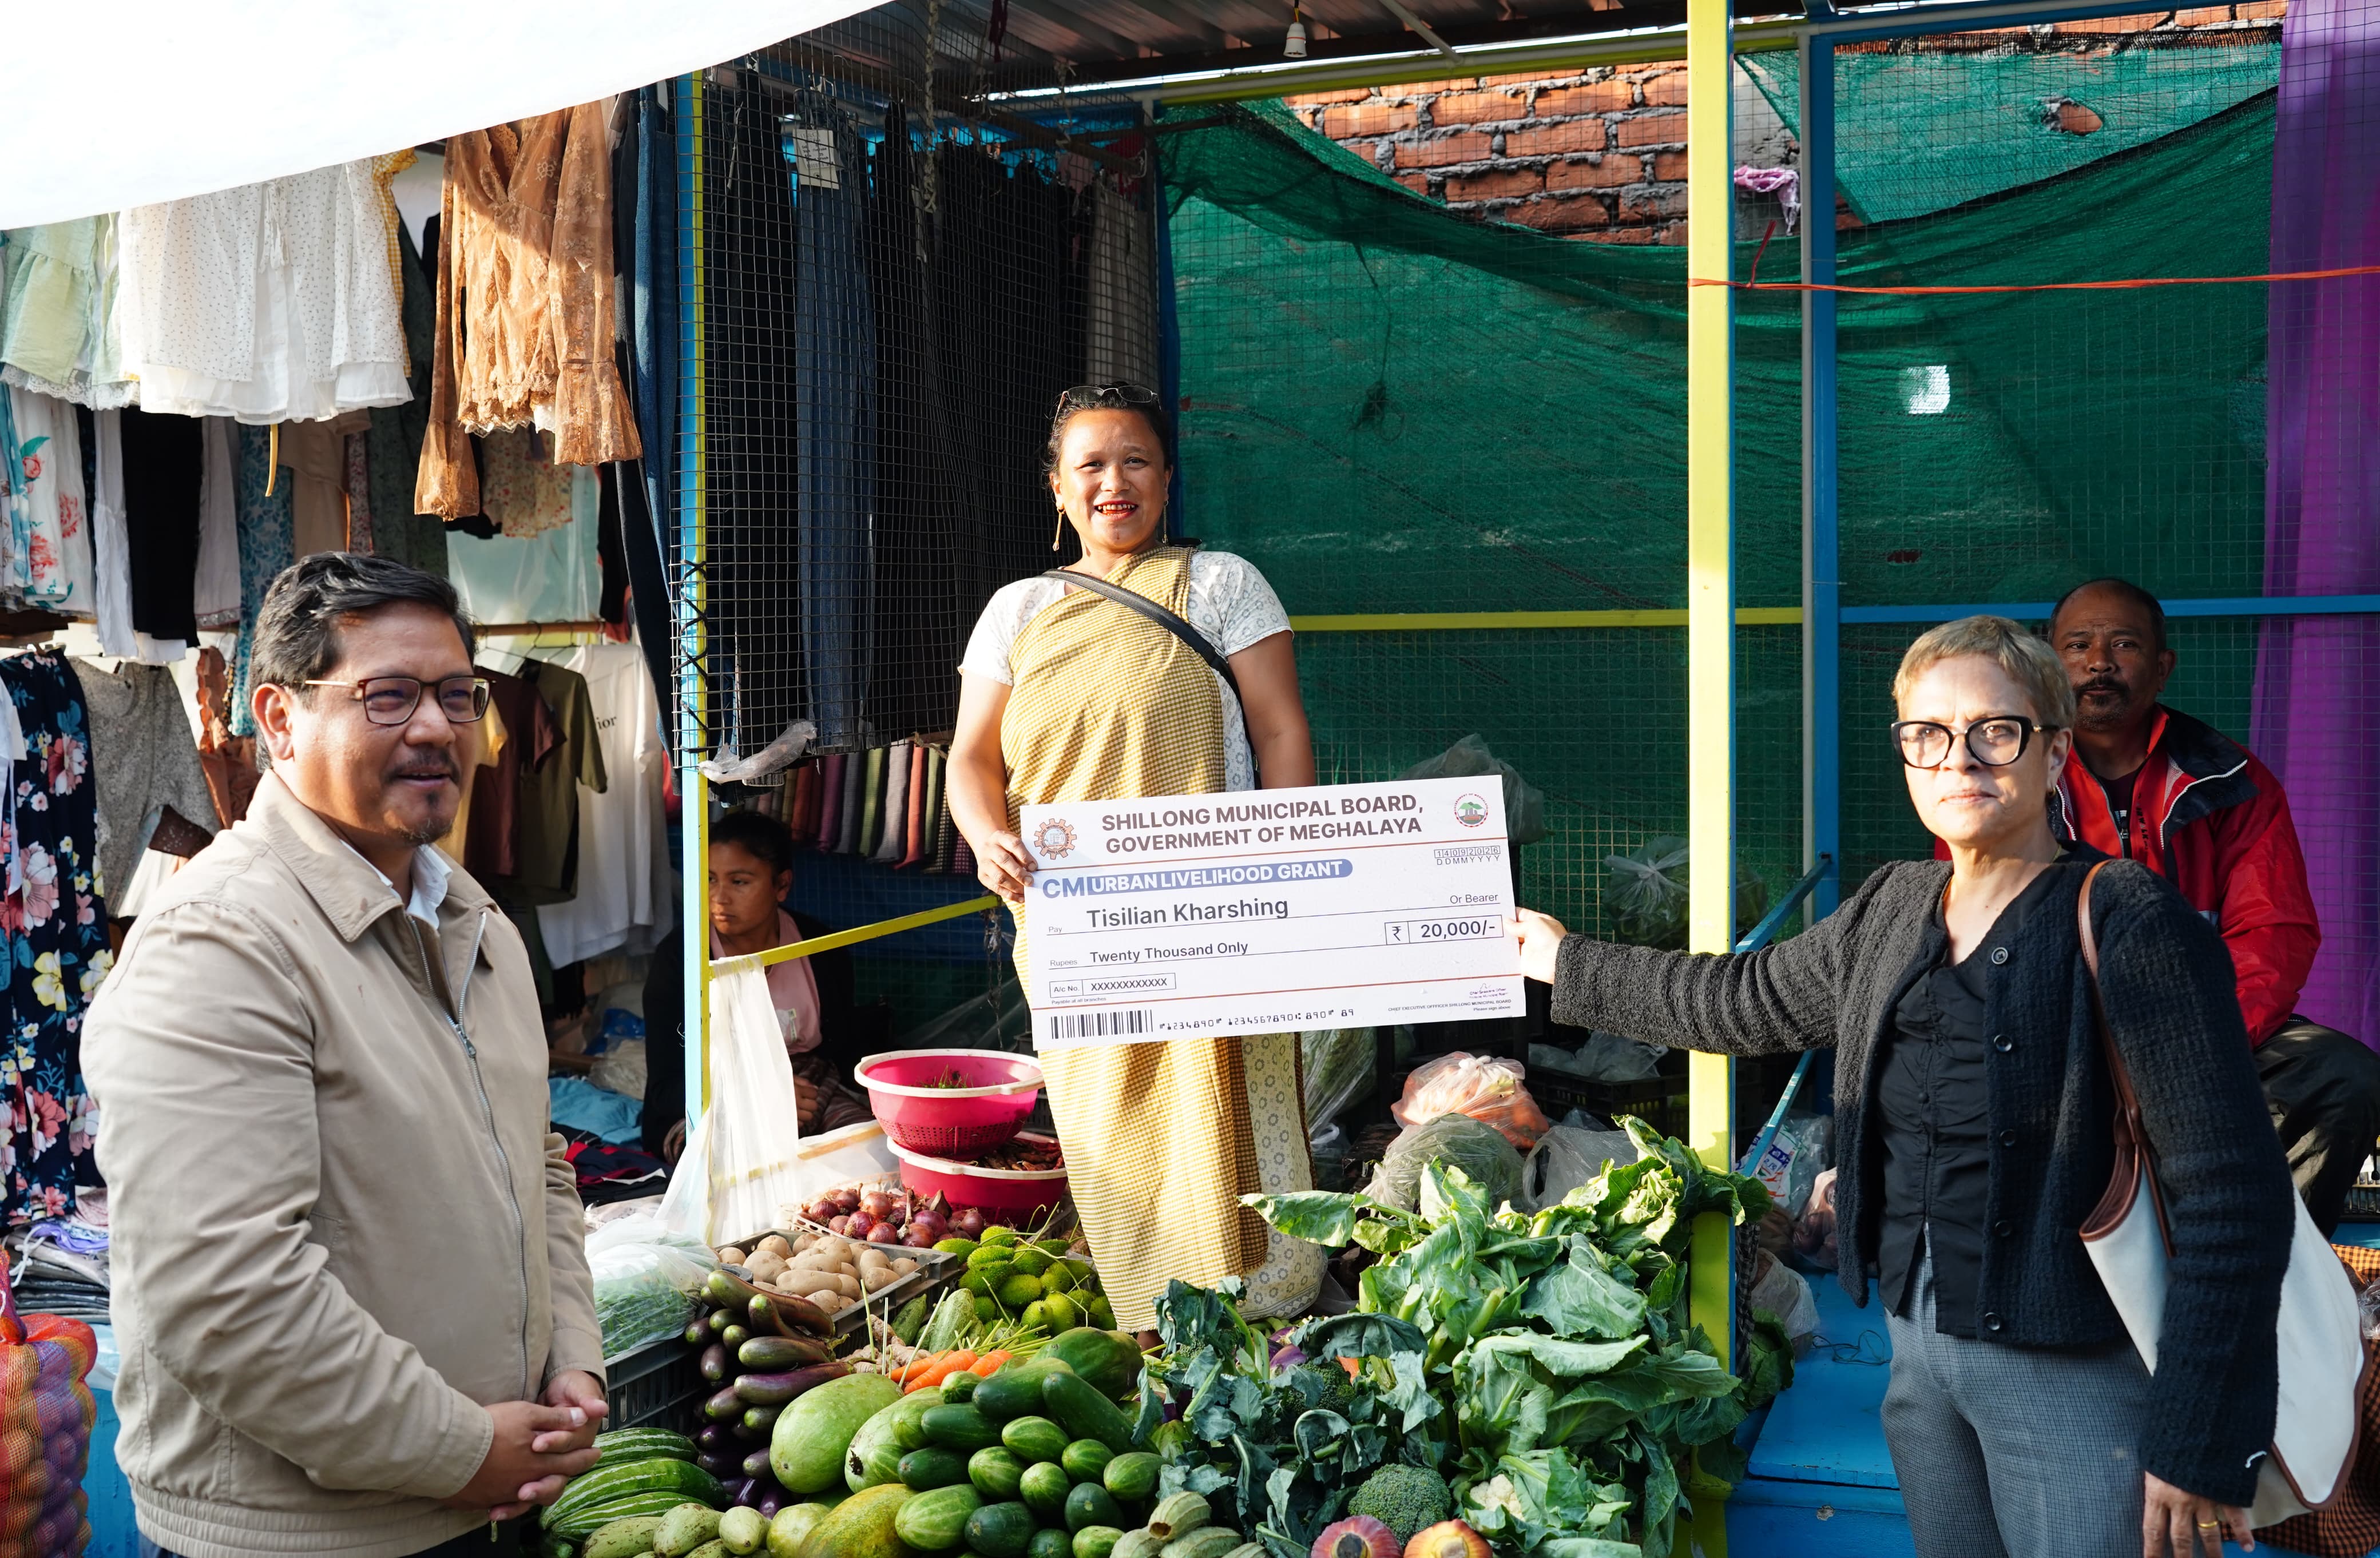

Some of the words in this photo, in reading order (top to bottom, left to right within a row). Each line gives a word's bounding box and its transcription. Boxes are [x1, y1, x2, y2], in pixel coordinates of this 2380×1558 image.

[597, 716, 617, 730] ior
[1102, 809, 1210, 830] SHILLONG
[1216, 800, 1336, 823] MUNICIPAL
[1341, 794, 1423, 814] BOARD,
[1106, 829, 1252, 853] GOVERNMENT
[1258, 826, 1284, 842] OF
[1290, 817, 1422, 841] MEGHALAYA
[1042, 878, 1084, 899] CM
[1091, 873, 1157, 892] URBAN
[1161, 867, 1272, 887] LIVELIHOOD
[1277, 861, 1342, 879] GRANT
[1450, 895, 1462, 904] Or
[1465, 894, 1498, 903] Bearer
[1048, 926, 1062, 934] Pay
[1086, 906, 1167, 928] Tisilian
[1173, 897, 1288, 921] Kharshing
[1421, 920, 1495, 939] 20,000/-
[1050, 959, 1077, 968] Rupees
[1090, 950, 1140, 963] Twenty
[1144, 944, 1213, 959] Thousand
[1217, 941, 1248, 955] Only
